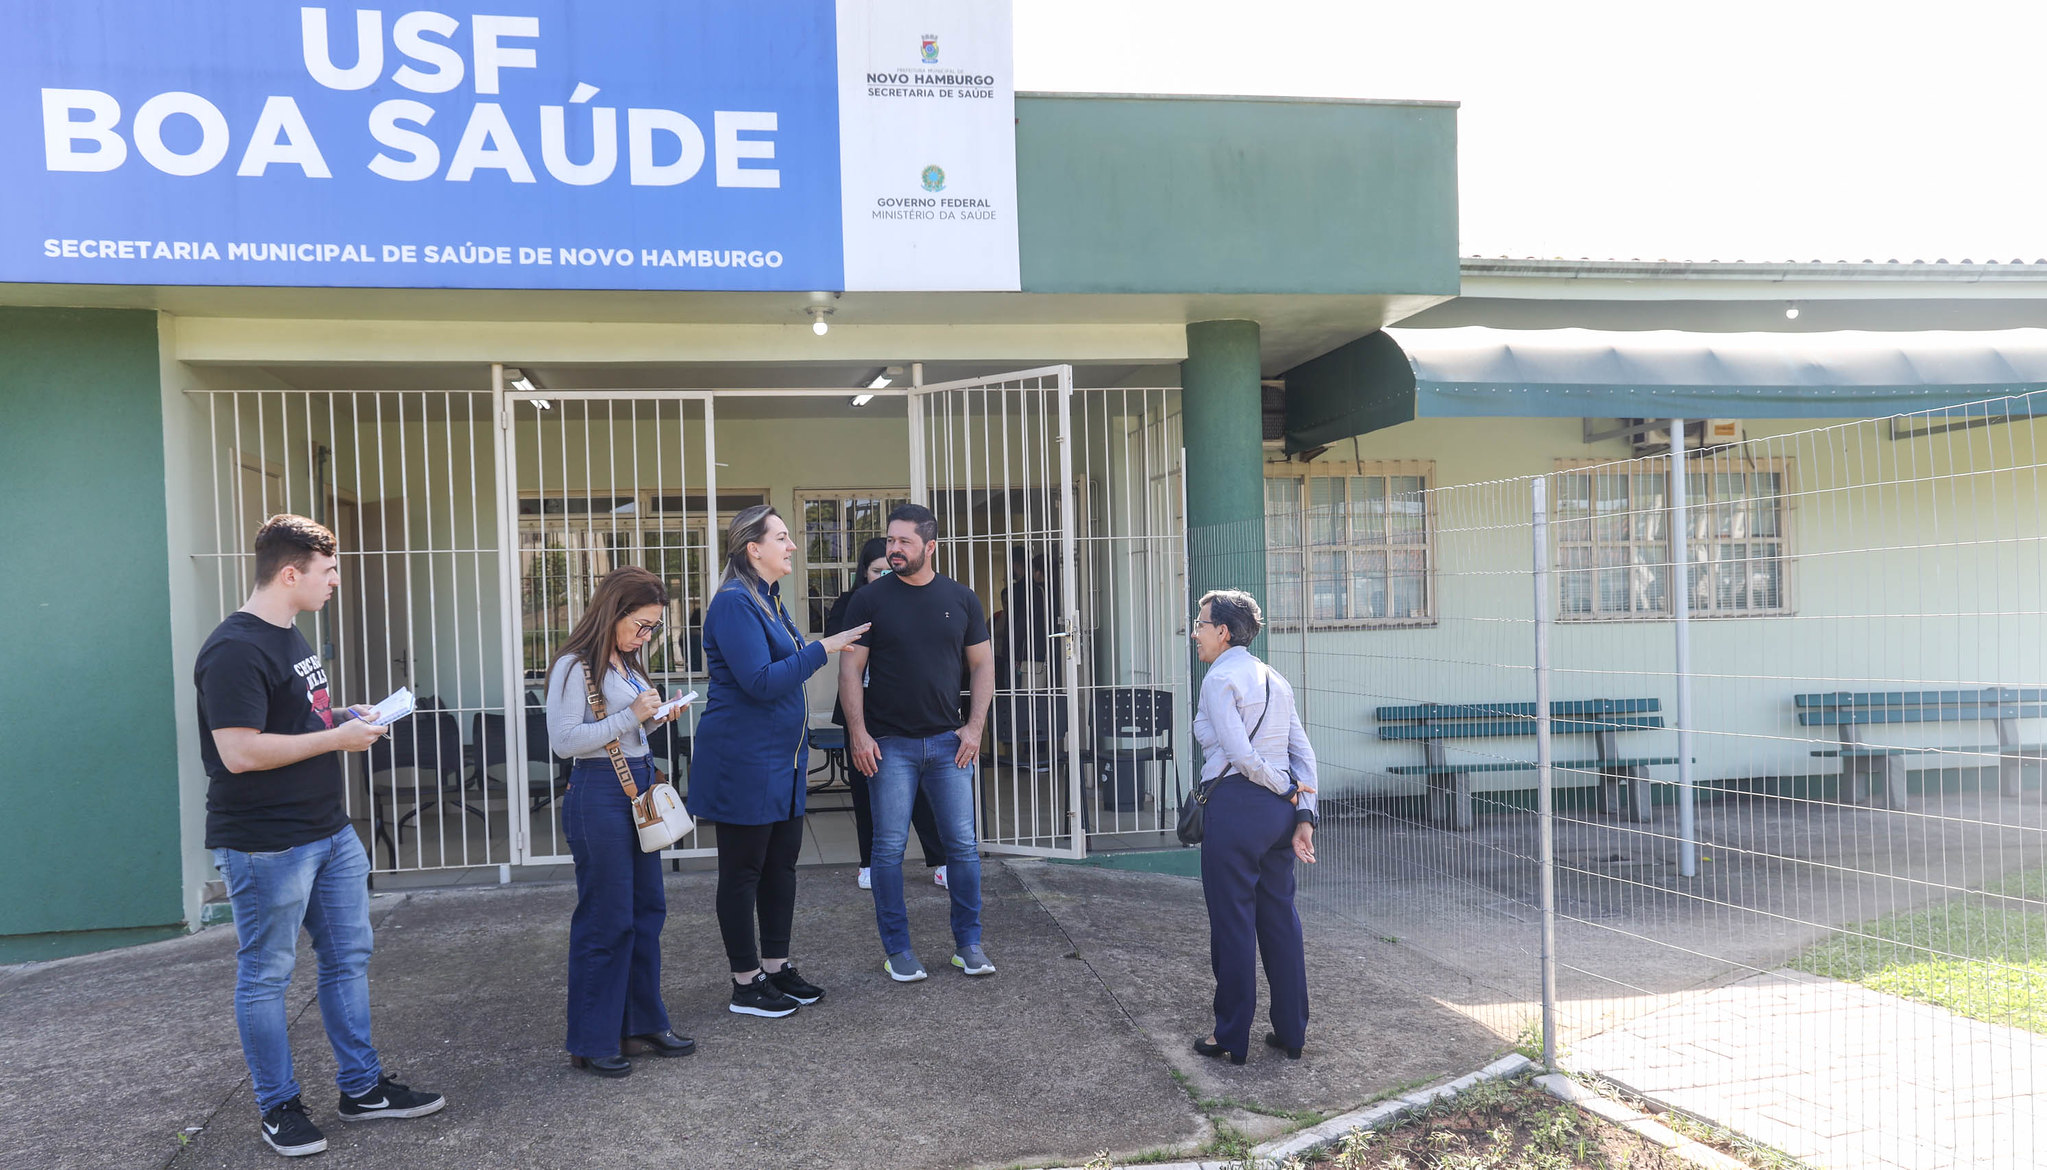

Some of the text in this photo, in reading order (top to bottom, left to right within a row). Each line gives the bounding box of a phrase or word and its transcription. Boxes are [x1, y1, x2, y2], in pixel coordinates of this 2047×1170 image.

[300, 6, 540, 95] USF
[866, 73, 995, 86] NOVO HAMBURGO
[868, 87, 994, 99] SECRETARIA DE SAÚDE
[40, 82, 781, 189] BOA SAÚDE
[877, 197, 991, 208] GOVERNO FEDERAL
[872, 208, 997, 220] MINISTÉRIO DA SAÚDE
[43, 238, 784, 269] SECRETARIA MUNICIPAL DE SAÚDE DE NOVO HAMBURGO
